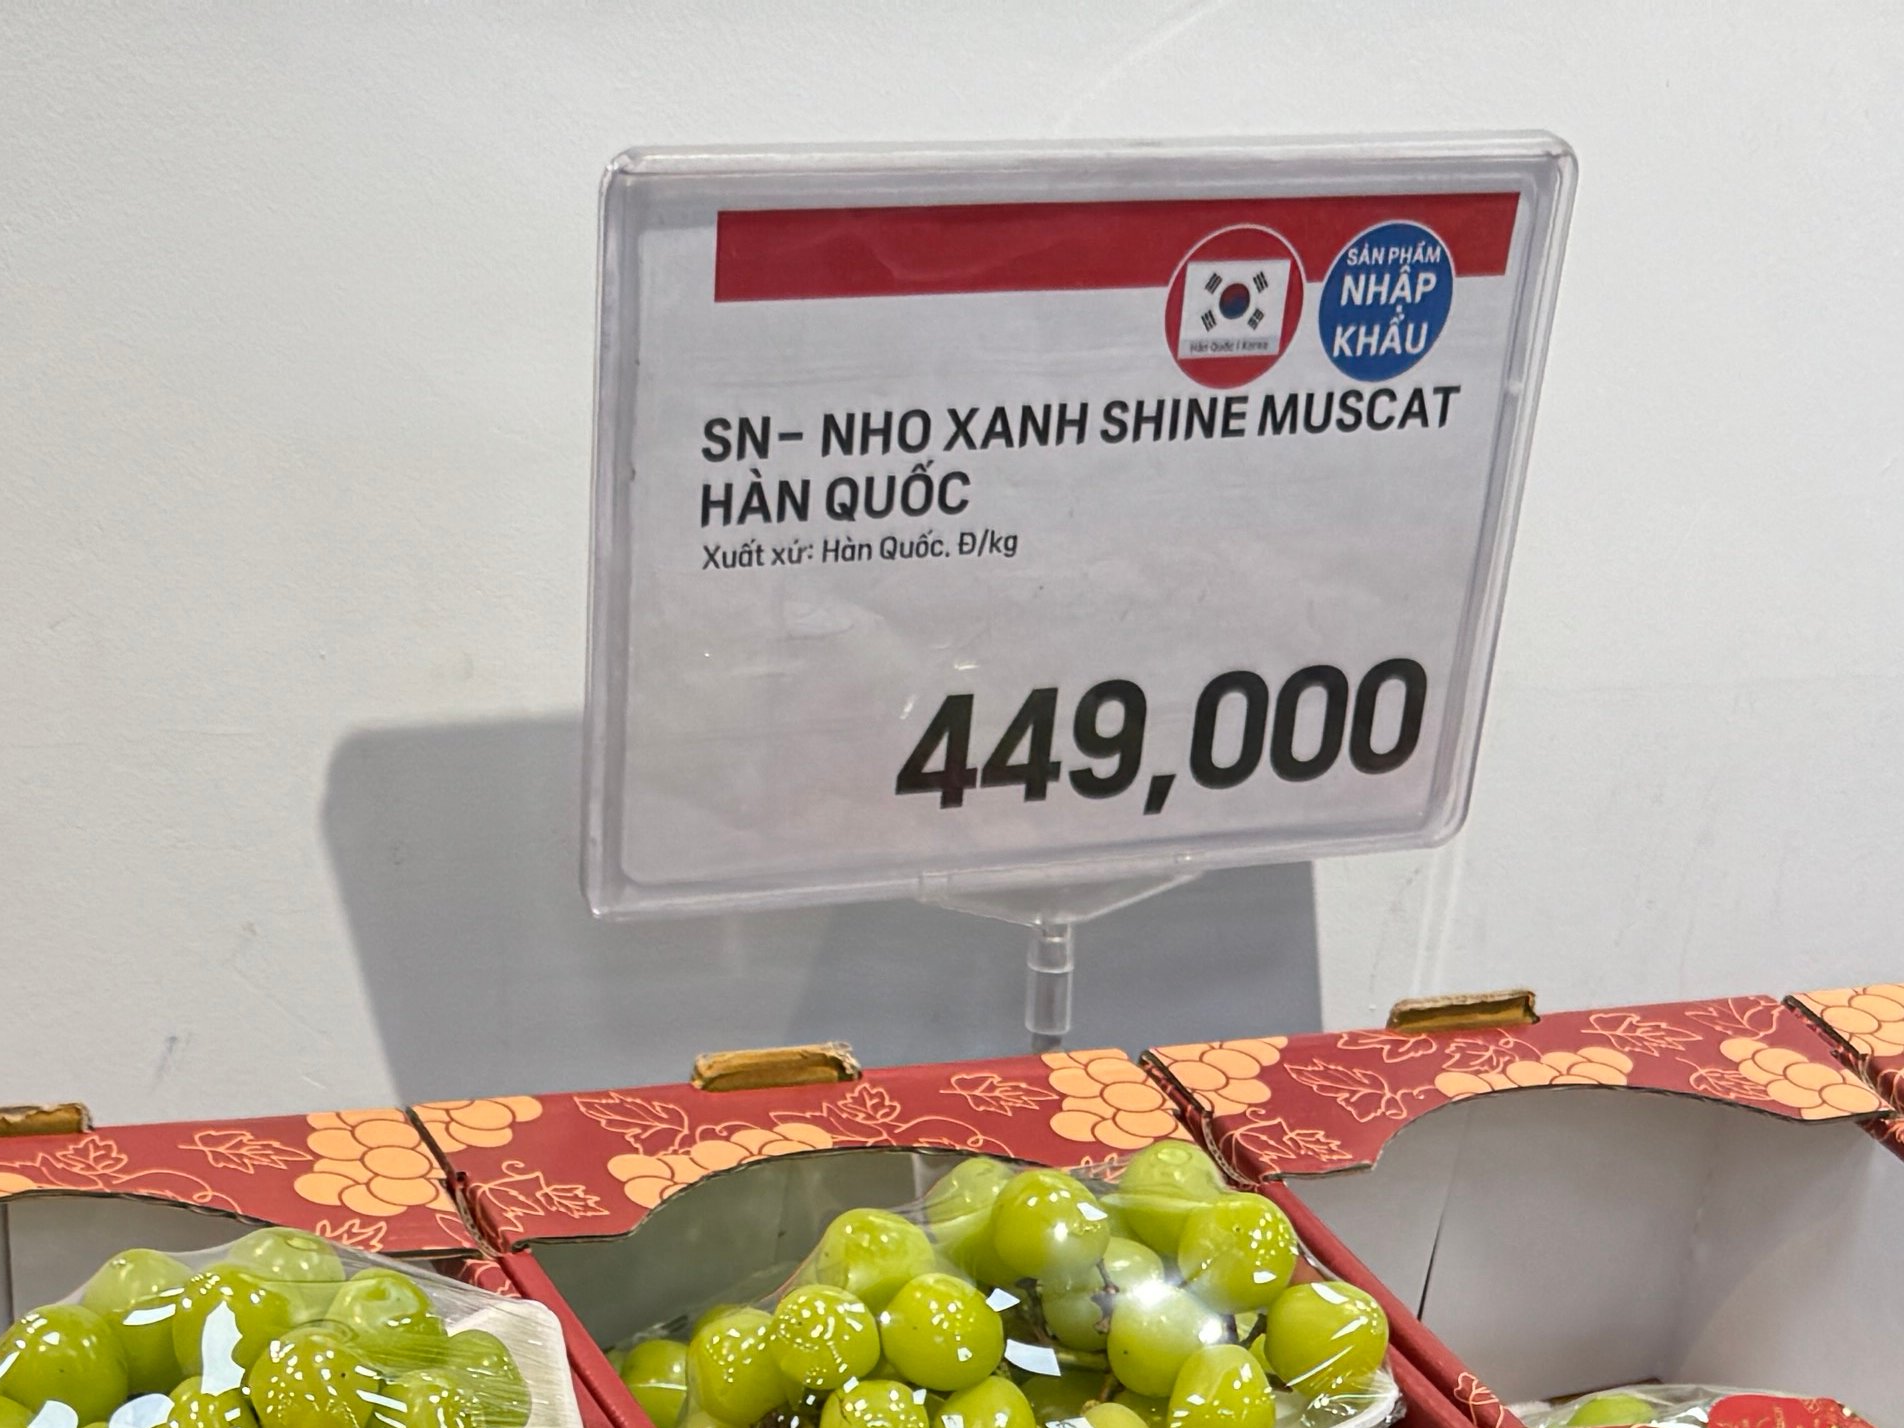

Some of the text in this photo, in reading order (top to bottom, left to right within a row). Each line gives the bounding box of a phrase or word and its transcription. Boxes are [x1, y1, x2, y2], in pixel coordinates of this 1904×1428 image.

[1347, 244, 1384, 266] SẢN
[1340, 265, 1436, 312] NHẬP
[1332, 311, 1428, 357] KHẨU
[821, 408, 932, 458] NHO
[943, 402, 1089, 451] XANH
[1098, 395, 1249, 444] SHINE
[1256, 385, 1461, 438] MUSCAT
[701, 459, 971, 528] HÀN QUỐC
[702, 529, 1018, 570] Xuất xứ: Hàn Quốc. Đ/kg
[896, 658, 1428, 816] 449,000
